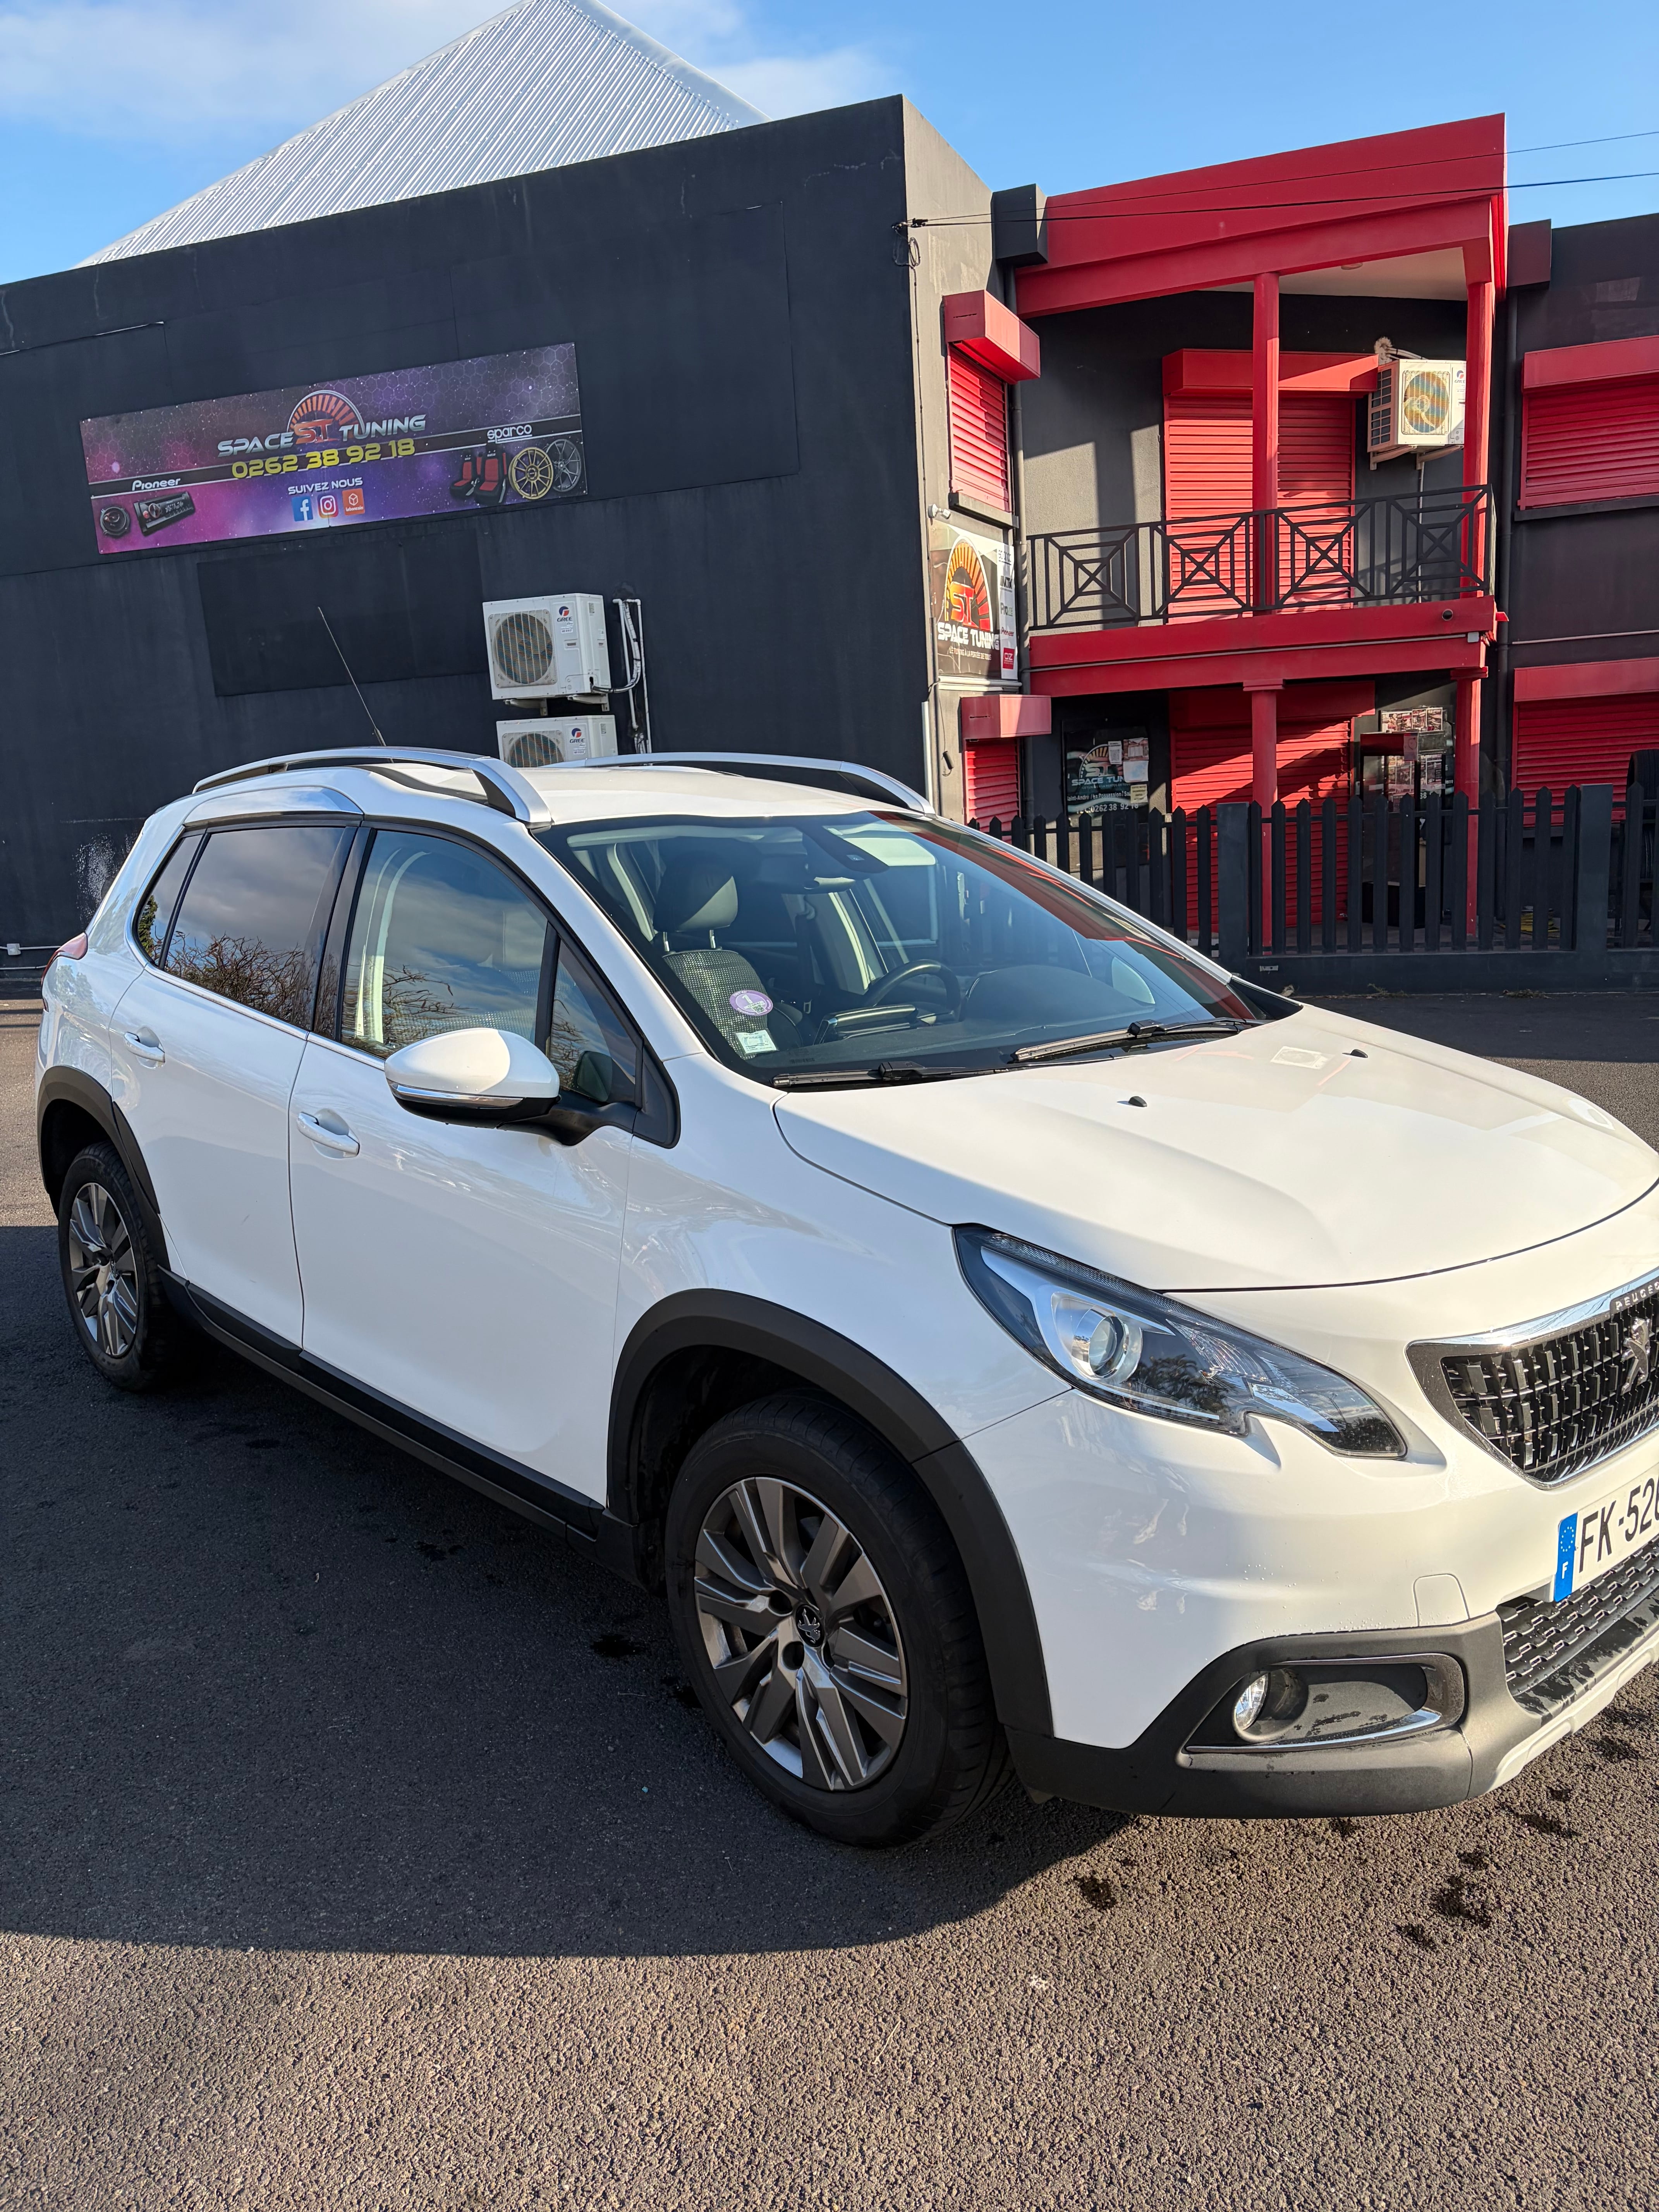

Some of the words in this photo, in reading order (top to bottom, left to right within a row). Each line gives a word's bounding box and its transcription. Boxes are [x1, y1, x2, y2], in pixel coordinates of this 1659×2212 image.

[218, 431, 295, 457] SPACE
[339, 414, 426, 441] TUNING
[487, 424, 532, 444] sparco
[232, 454, 298, 479] 0262
[306, 449, 340, 469] 38
[346, 443, 381, 463] 92
[388, 438, 415, 458] 18
[132, 478, 181, 491] Pioneer
[288, 482, 329, 495] SUIVEZ
[331, 477, 363, 489] NOUS
[938, 622, 969, 645] SPACE
[970, 629, 1000, 650] TUNING
[1072, 777, 1104, 786] SPACE
[742, 994, 753, 1004] 1
[1579, 1475, 1659, 1573] FK-52
[1562, 1561, 1568, 1579] F
